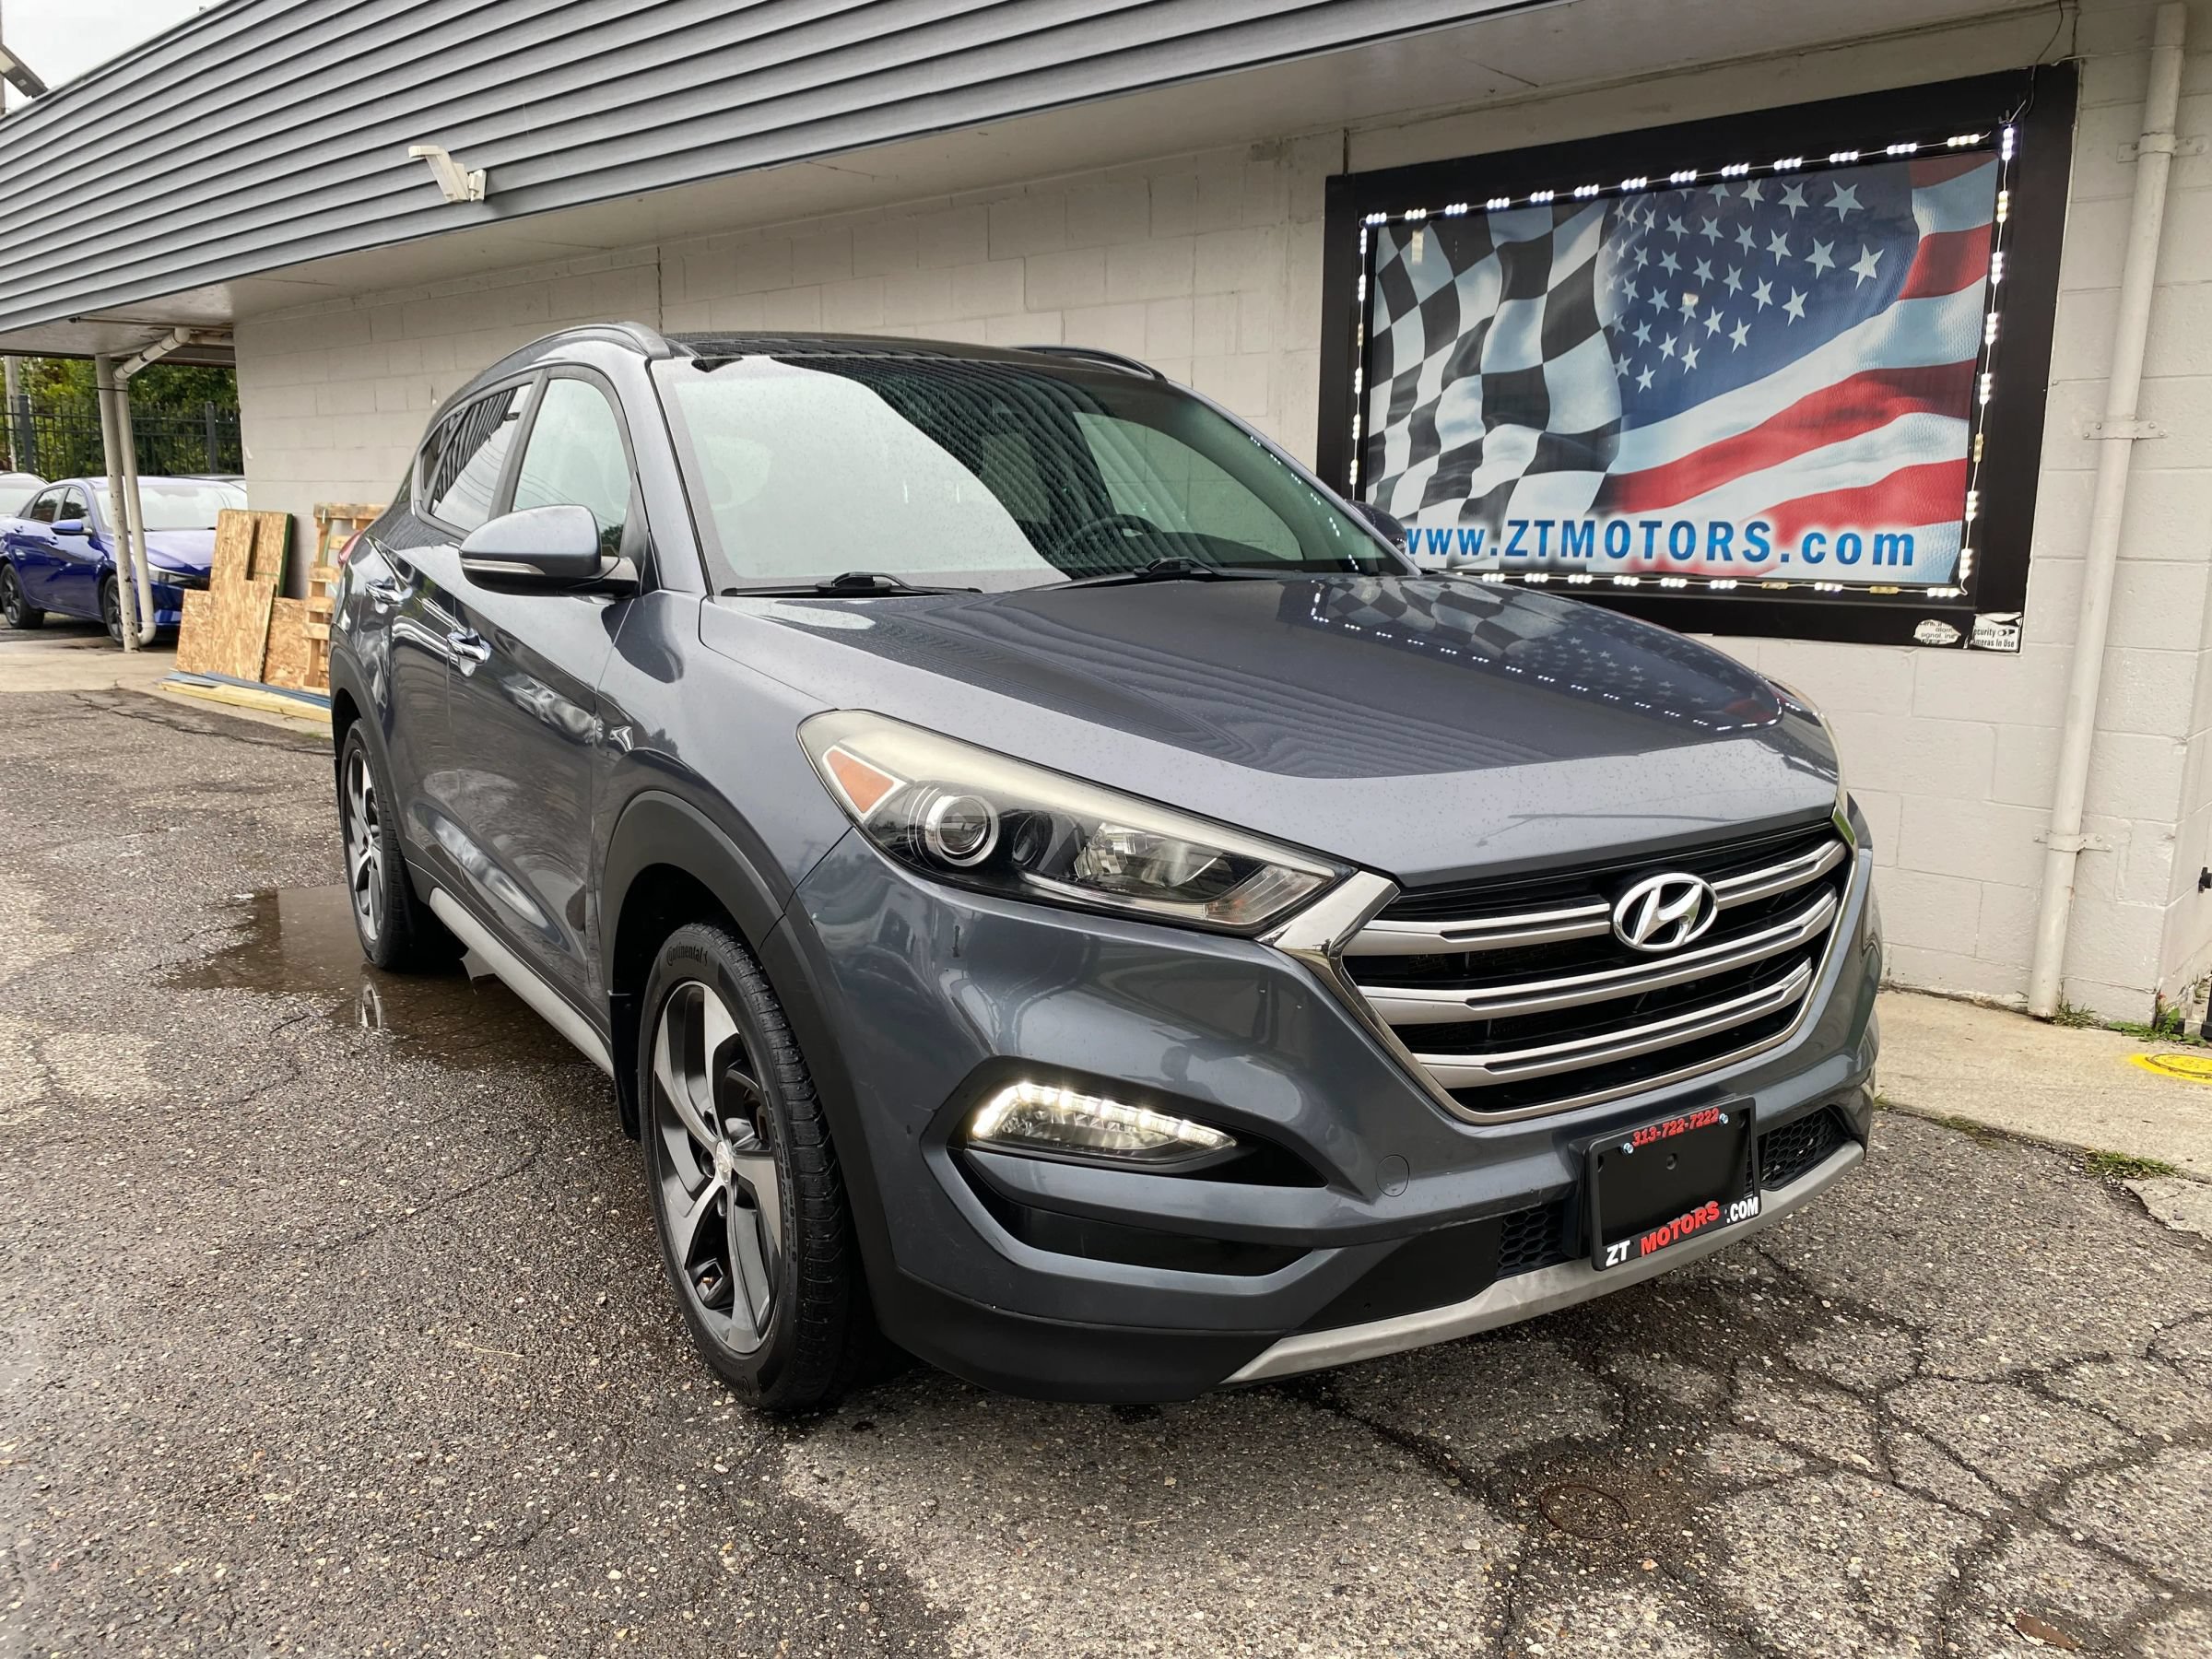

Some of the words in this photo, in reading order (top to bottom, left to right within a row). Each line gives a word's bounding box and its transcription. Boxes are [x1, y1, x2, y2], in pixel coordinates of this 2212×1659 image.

[1405, 520, 1914, 566] www.ZTMOTORS.com
[666, 940, 704, 967] Continental
[1631, 1107, 1720, 1147] 313-722-7222
[1606, 1240, 1631, 1267] ZT
[1640, 1200, 1720, 1257] MOTORS
